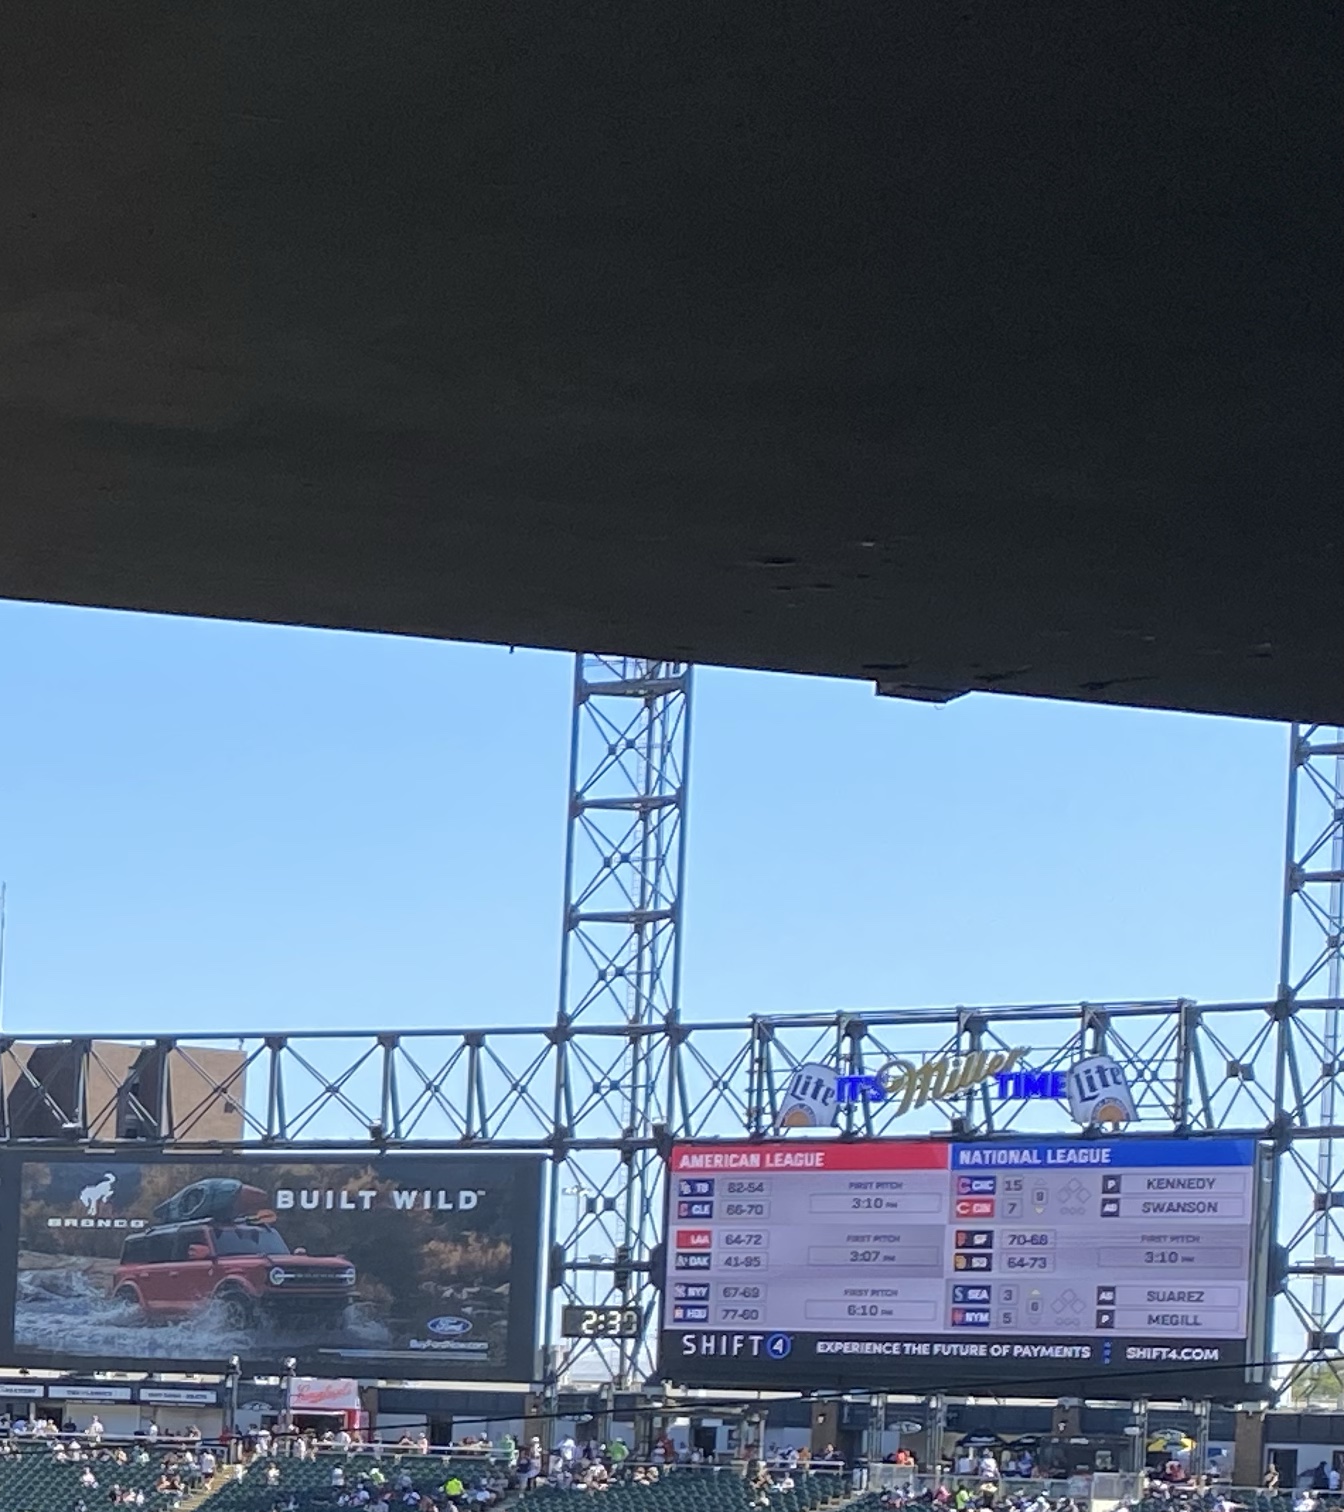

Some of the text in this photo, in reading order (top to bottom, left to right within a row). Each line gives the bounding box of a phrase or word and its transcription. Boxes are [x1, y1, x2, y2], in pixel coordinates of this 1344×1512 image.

[874, 1047, 1030, 1116] Miller
[996, 1071, 1067, 1099] TIME
[1074, 1064, 1122, 1099] Lite
[791, 1075, 835, 1105] Lite
[679, 1152, 825, 1168] AMERICAN LEAGUE
[960, 1149, 1111, 1164] NATIONAL LEAGUE
[1004, 1178, 1216, 1191] 15 KENNEDY
[277, 1190, 478, 1210] BUILT WILD
[852, 1198, 883, 1208] 3:10
[1142, 1202, 1218, 1213] SWANSON
[47, 1218, 144, 1229] BRONCO
[850, 1251, 879, 1262] 3:07
[1144, 1252, 1178, 1262] 3:10
[1148, 1291, 1204, 1302] SUAREZ
[1148, 1314, 1201, 1326] MEGILL
[682, 1334, 763, 1357] SHIFT
[816, 1342, 1219, 1361] EXPERIENCE THE FUTURE OF PAYMENTS SHIFT4.COM
